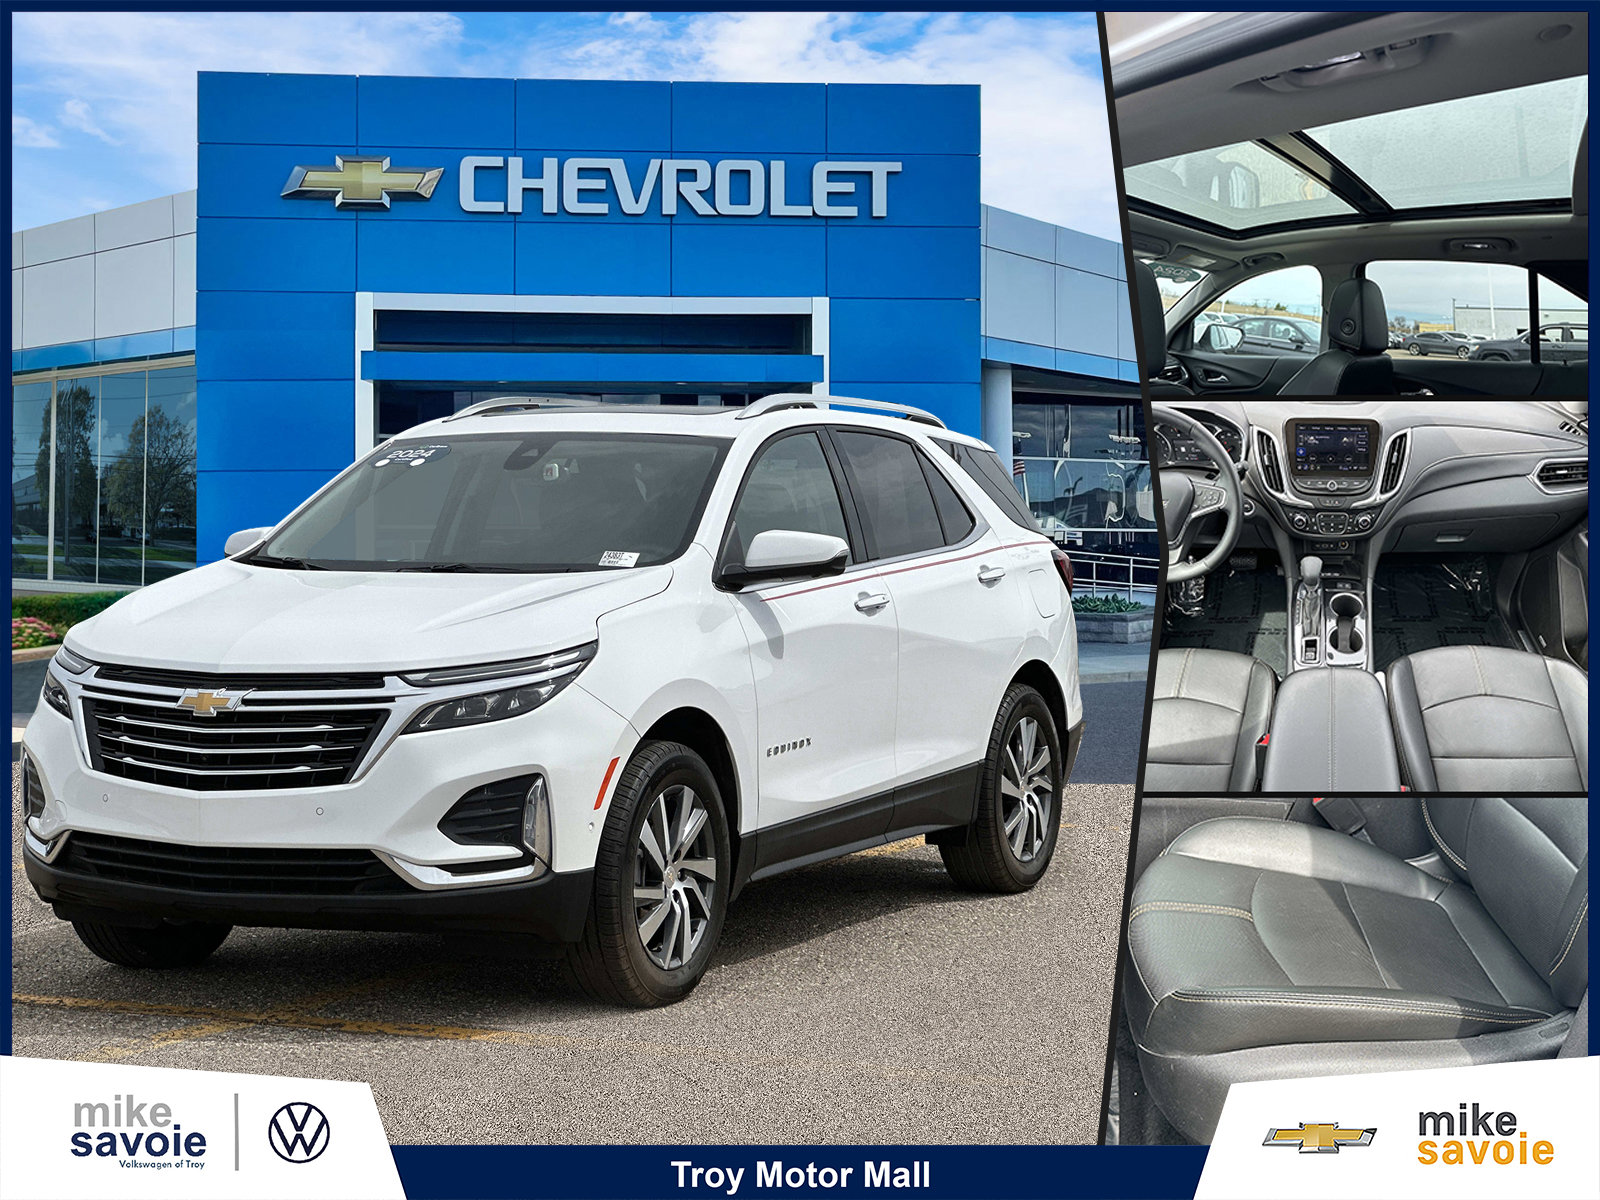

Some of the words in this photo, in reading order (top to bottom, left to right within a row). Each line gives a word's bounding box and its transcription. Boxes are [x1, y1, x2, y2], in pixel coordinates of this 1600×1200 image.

[458, 155, 903, 218] CHEVROLET
[386, 449, 436, 458] 2024
[766, 737, 812, 758] EQUINOX
